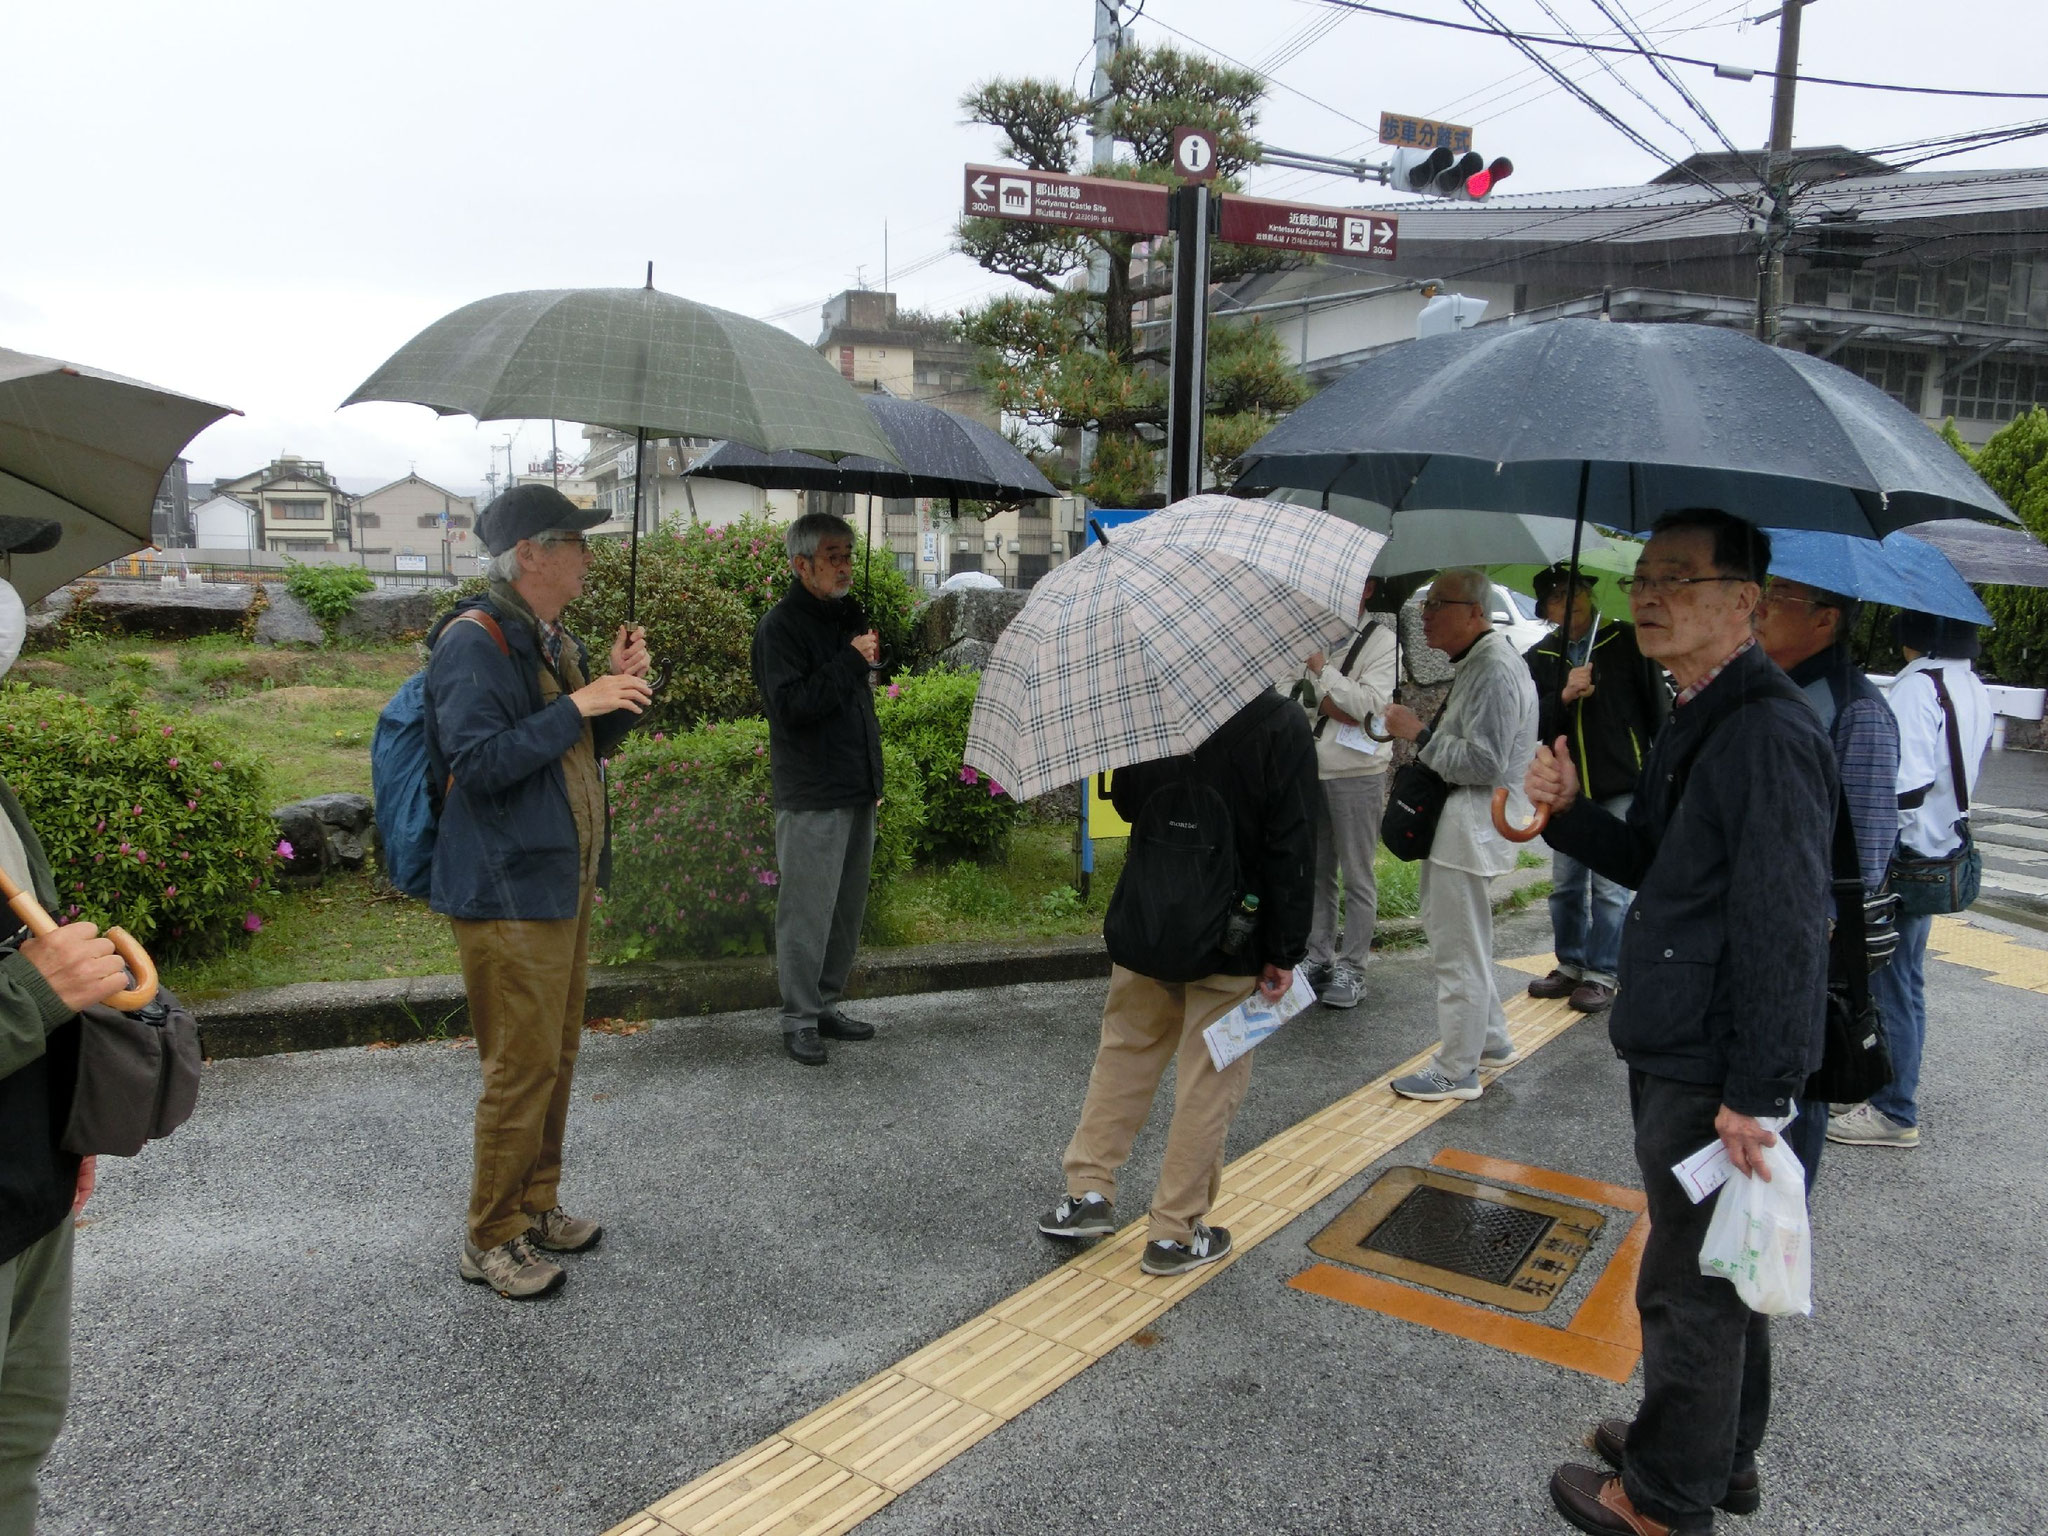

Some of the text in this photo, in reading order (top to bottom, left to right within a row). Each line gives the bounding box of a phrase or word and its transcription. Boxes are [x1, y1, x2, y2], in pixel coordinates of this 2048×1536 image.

[1383, 116, 1471, 152] 歩車分離式
[1035, 182, 1081, 199] 郡山城跡
[971, 202, 996, 212] 300m
[1035, 197, 1107, 212] Koriyama Castle Site
[1289, 212, 1338, 229] 近鉄郡山駅
[1268, 224, 1338, 238] Kintetsu Koriyama Sta.
[1373, 245, 1393, 255] 300m
